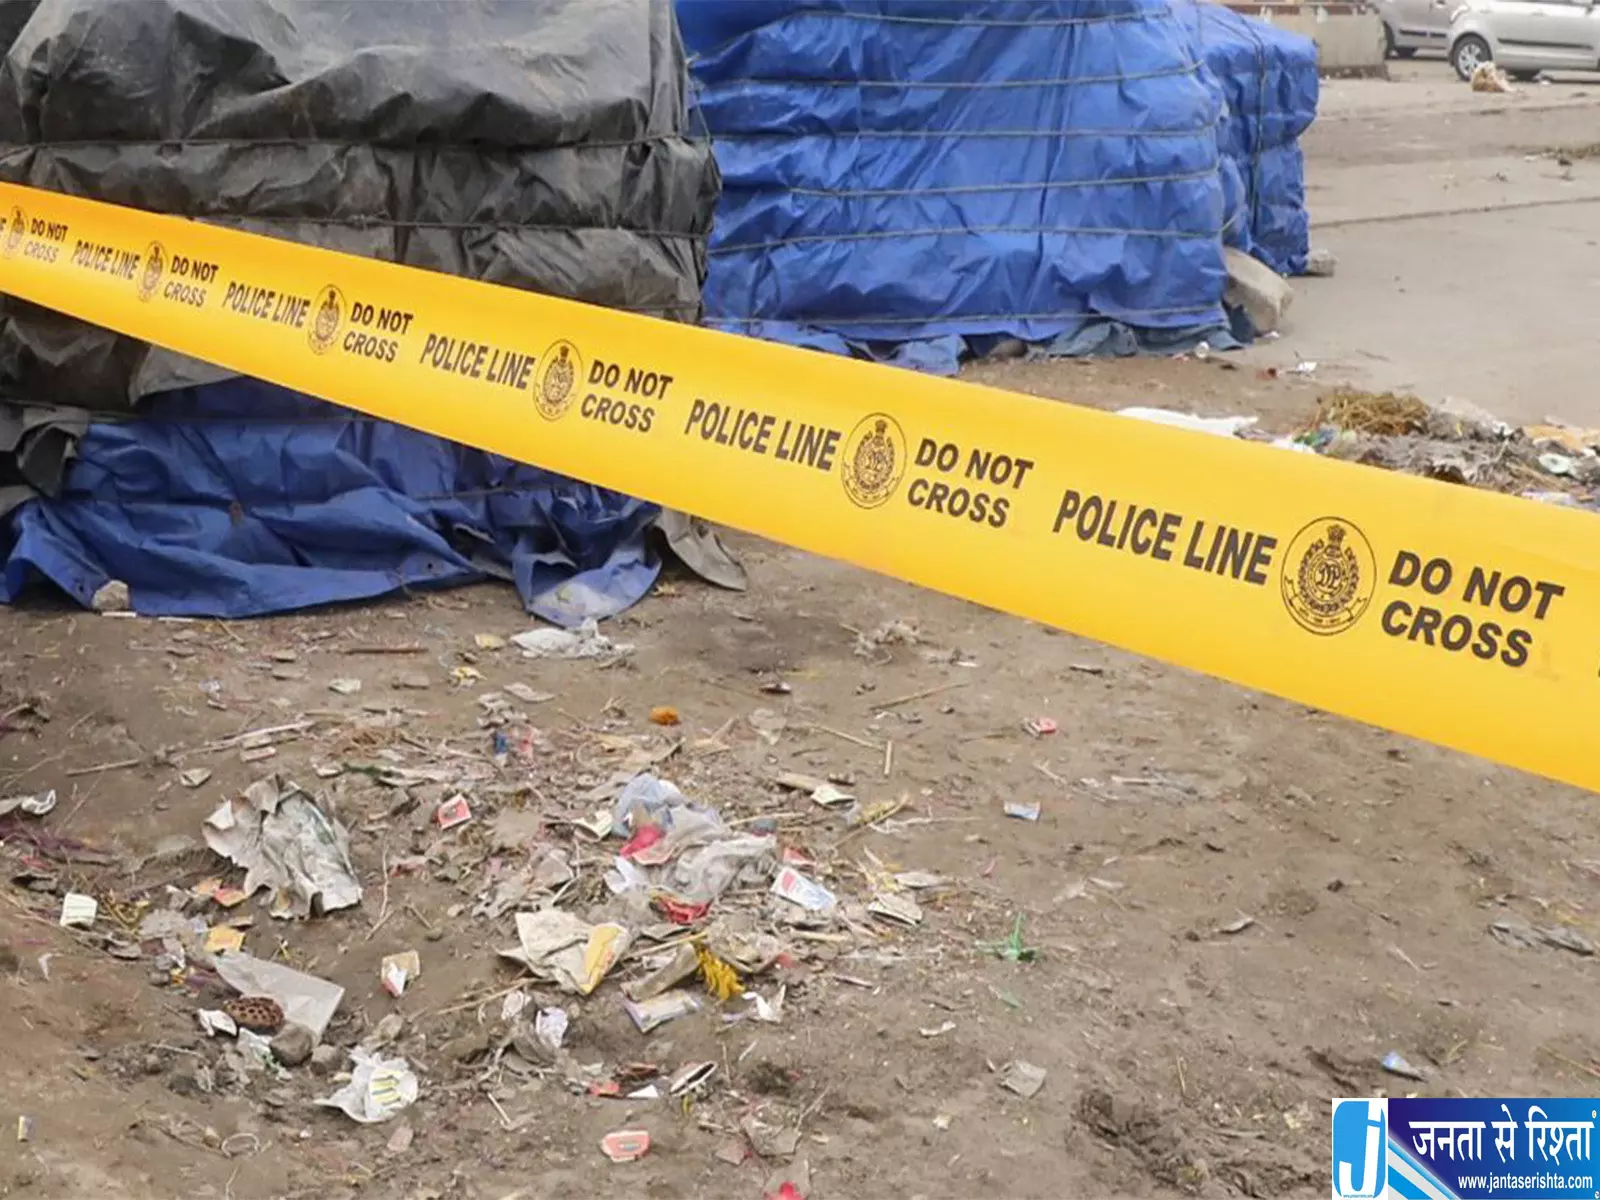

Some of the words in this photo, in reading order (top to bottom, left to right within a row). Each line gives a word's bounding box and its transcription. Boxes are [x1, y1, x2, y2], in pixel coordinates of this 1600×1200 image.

[31, 217, 46, 237] DO
[47, 223, 69, 242] NOT
[24, 240, 60, 263] CROSS
[71, 239, 114, 272] POLICE
[110, 249, 141, 280] LINE
[171, 256, 190, 276] DO
[191, 261, 220, 284] NOT
[163, 281, 207, 307] CROSS
[222, 281, 276, 321] POLICE
[272, 294, 311, 328] LINE
[350, 301, 375, 326] DO
[376, 308, 414, 335] NOT
[343, 331, 399, 363] CROSS
[419, 333, 488, 378] POLICE
[485, 349, 536, 390] LINE
[587, 359, 621, 389] DO
[623, 367, 674, 400] NOT
[580, 393, 655, 433] CROSS
[684, 398, 777, 455] POLICE
[774, 420, 842, 472] LINE
[914, 437, 960, 472] DO
[964, 449, 1035, 490] NOT
[907, 478, 1010, 529] CROSS
[1052, 489, 1183, 562] POLICE
[1182, 520, 1278, 586] LINE
[1387, 549, 1453, 596] DO
[1462, 566, 1566, 621] NOT
[1380, 599, 1533, 668] CROSS
